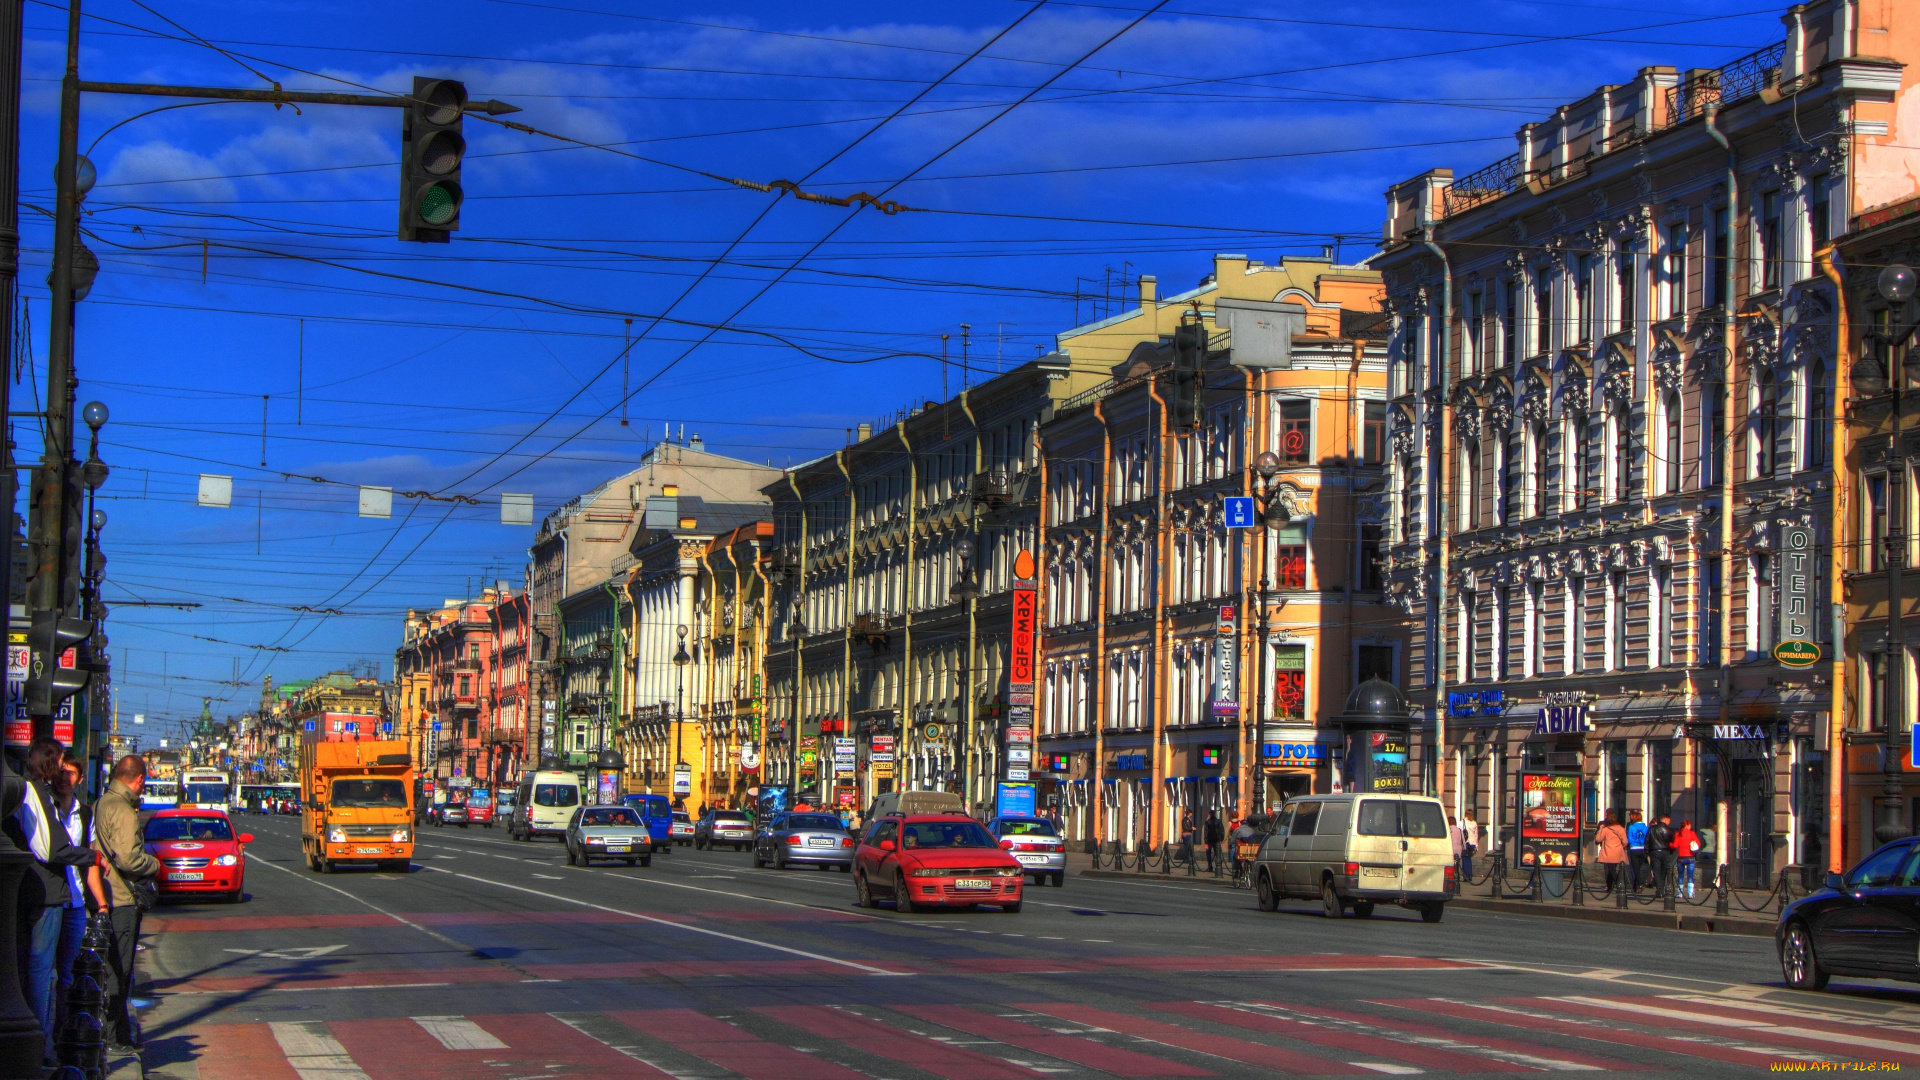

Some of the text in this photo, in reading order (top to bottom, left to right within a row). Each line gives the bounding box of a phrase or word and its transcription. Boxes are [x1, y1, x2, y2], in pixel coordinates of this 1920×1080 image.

[1789, 531, 1808, 637] ОТЕЛЬ
[1779, 651, 1816, 660] ПРИМАВЕРА
[1535, 705, 1596, 734] АВИС
[1713, 725, 1765, 739] МЕХА
[1385, 743, 1396, 752] 17
